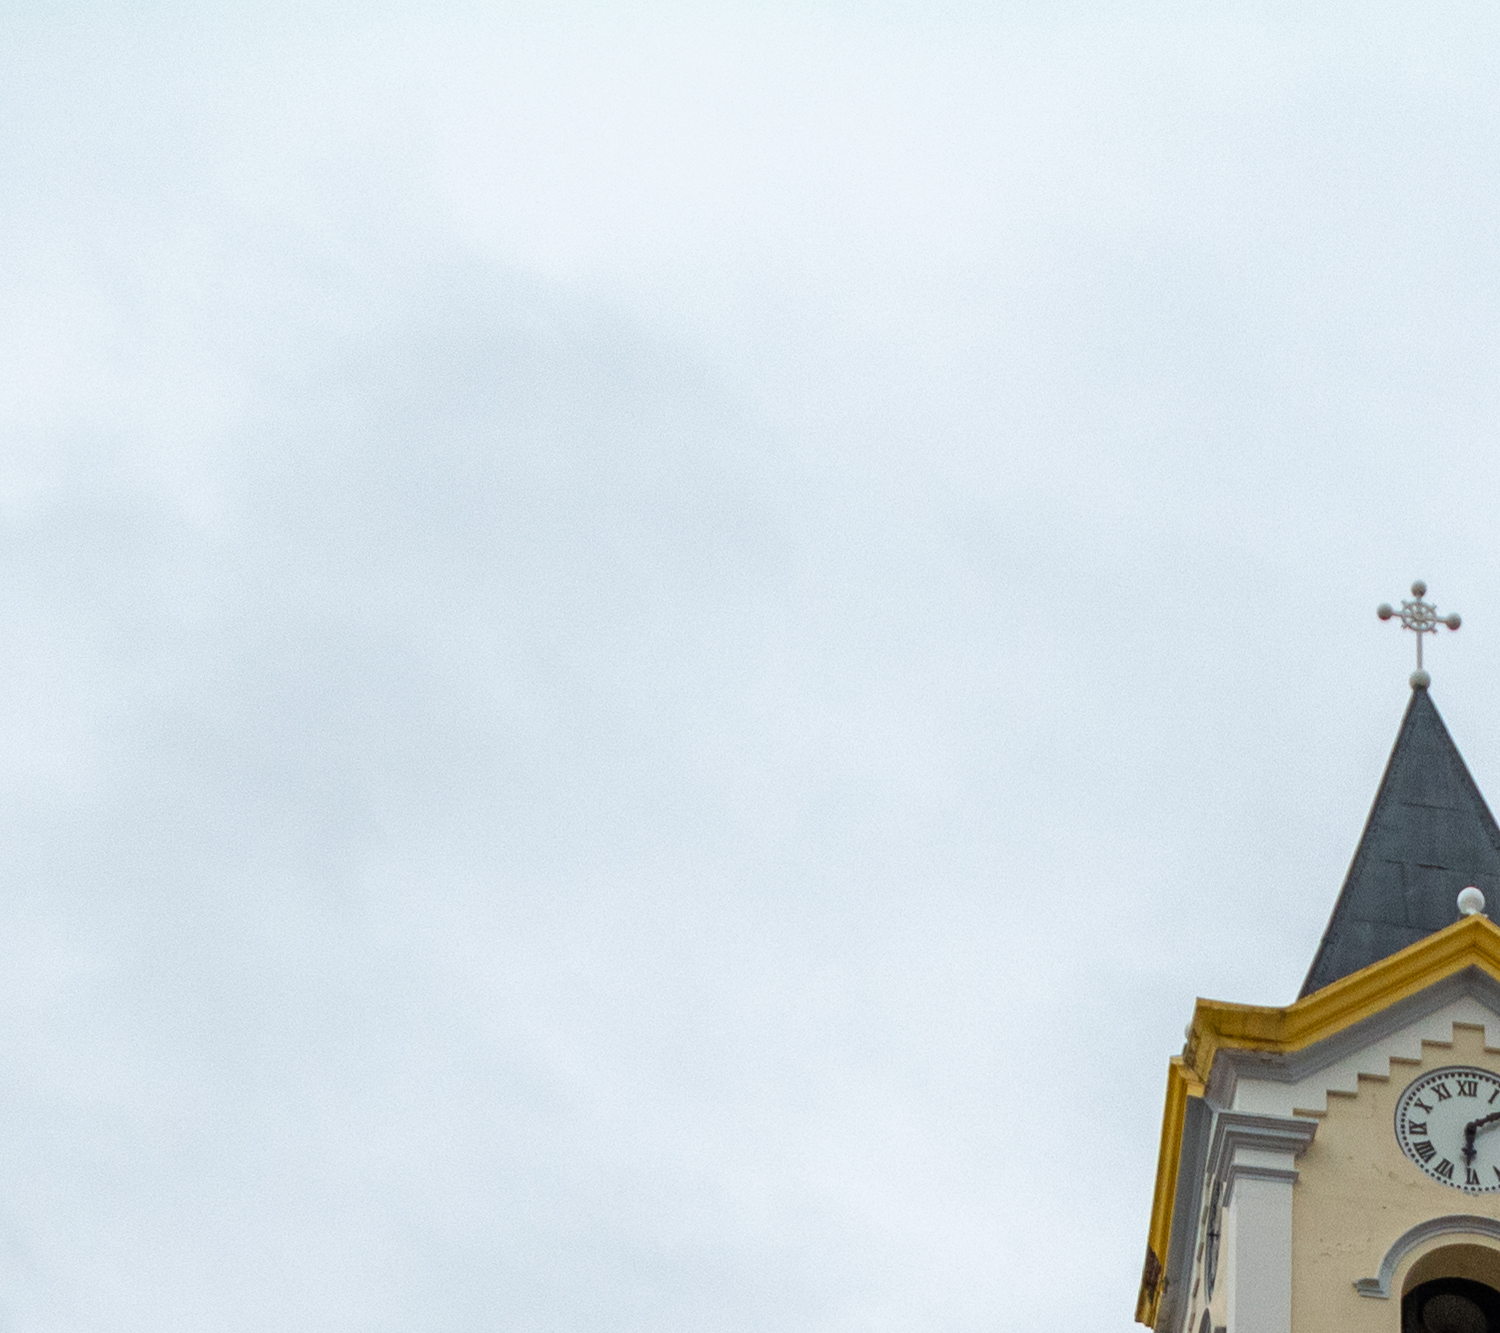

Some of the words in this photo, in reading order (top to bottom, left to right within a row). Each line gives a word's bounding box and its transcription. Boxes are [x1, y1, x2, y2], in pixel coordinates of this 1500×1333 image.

[1431, 1082, 1453, 1101] XI
[1457, 1080, 1479, 1097] XII
[1488, 1088, 1500, 1104] I
[1414, 1097, 1434, 1115] X
[1408, 1119, 1427, 1136] IX
[1413, 1140, 1437, 1164] VIII
[1433, 1158, 1455, 1180] VII
[1466, 1168, 1480, 1185] VI
